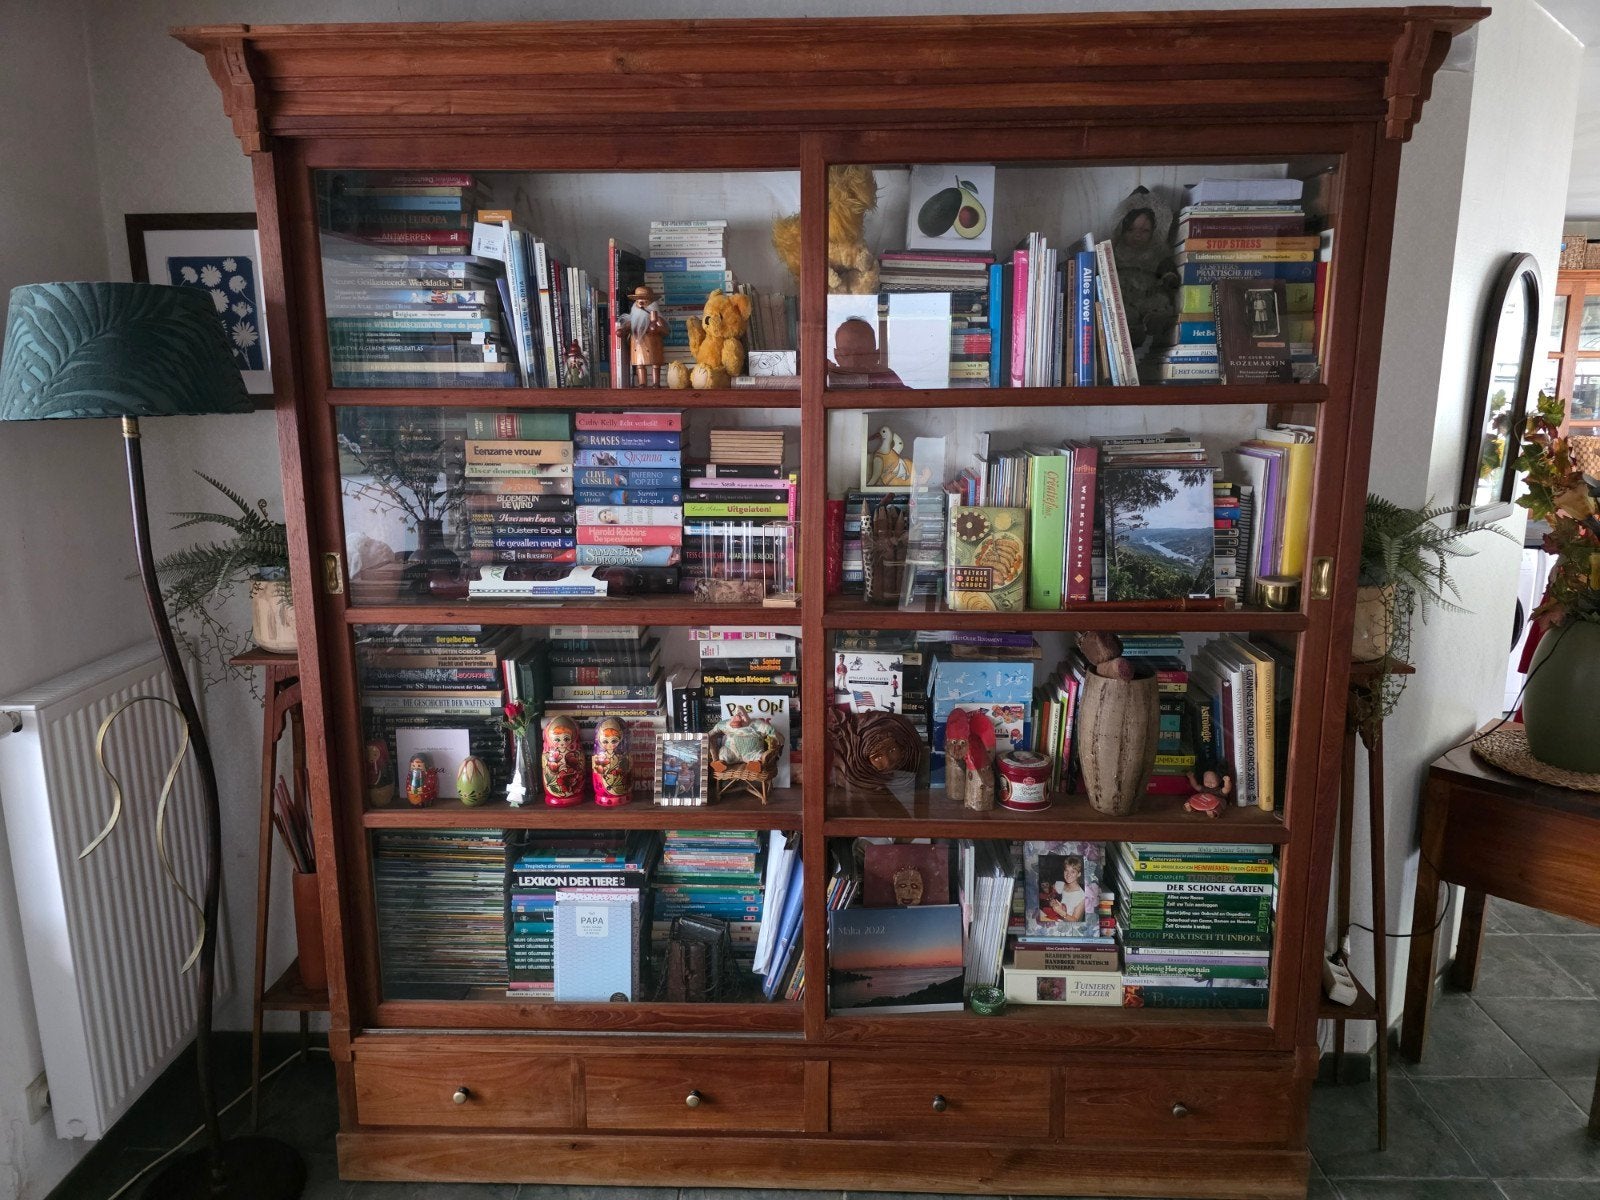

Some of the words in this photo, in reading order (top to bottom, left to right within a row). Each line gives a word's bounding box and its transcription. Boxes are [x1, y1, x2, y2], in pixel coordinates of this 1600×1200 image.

[409, 215, 448, 223] EUROPA
[1207, 240, 1228, 248] STOP
[1230, 240, 1262, 248] STRESS
[1083, 268, 1092, 294] Alles
[1083, 326, 1092, 364] Fitness
[590, 436, 620, 445] RAMSES
[474, 446, 512, 455] Eenzame
[589, 527, 614, 536] Harold
[616, 528, 647, 536] Robbins
[1077, 486, 1087, 568] WERKBLADEN
[507, 539, 538, 548] gevallen
[540, 539, 561, 548] engel
[758, 699, 784, 715] Op!
[1201, 706, 1212, 743] Astrologie
[519, 877, 566, 886] LEXIKON
[569, 877, 590, 886] DER
[591, 877, 619, 886] TIERE
[1142, 965, 1164, 973] Herwig
[1075, 982, 1116, 990] TUINIEREN
[1153, 992, 1238, 1008] Botanica
